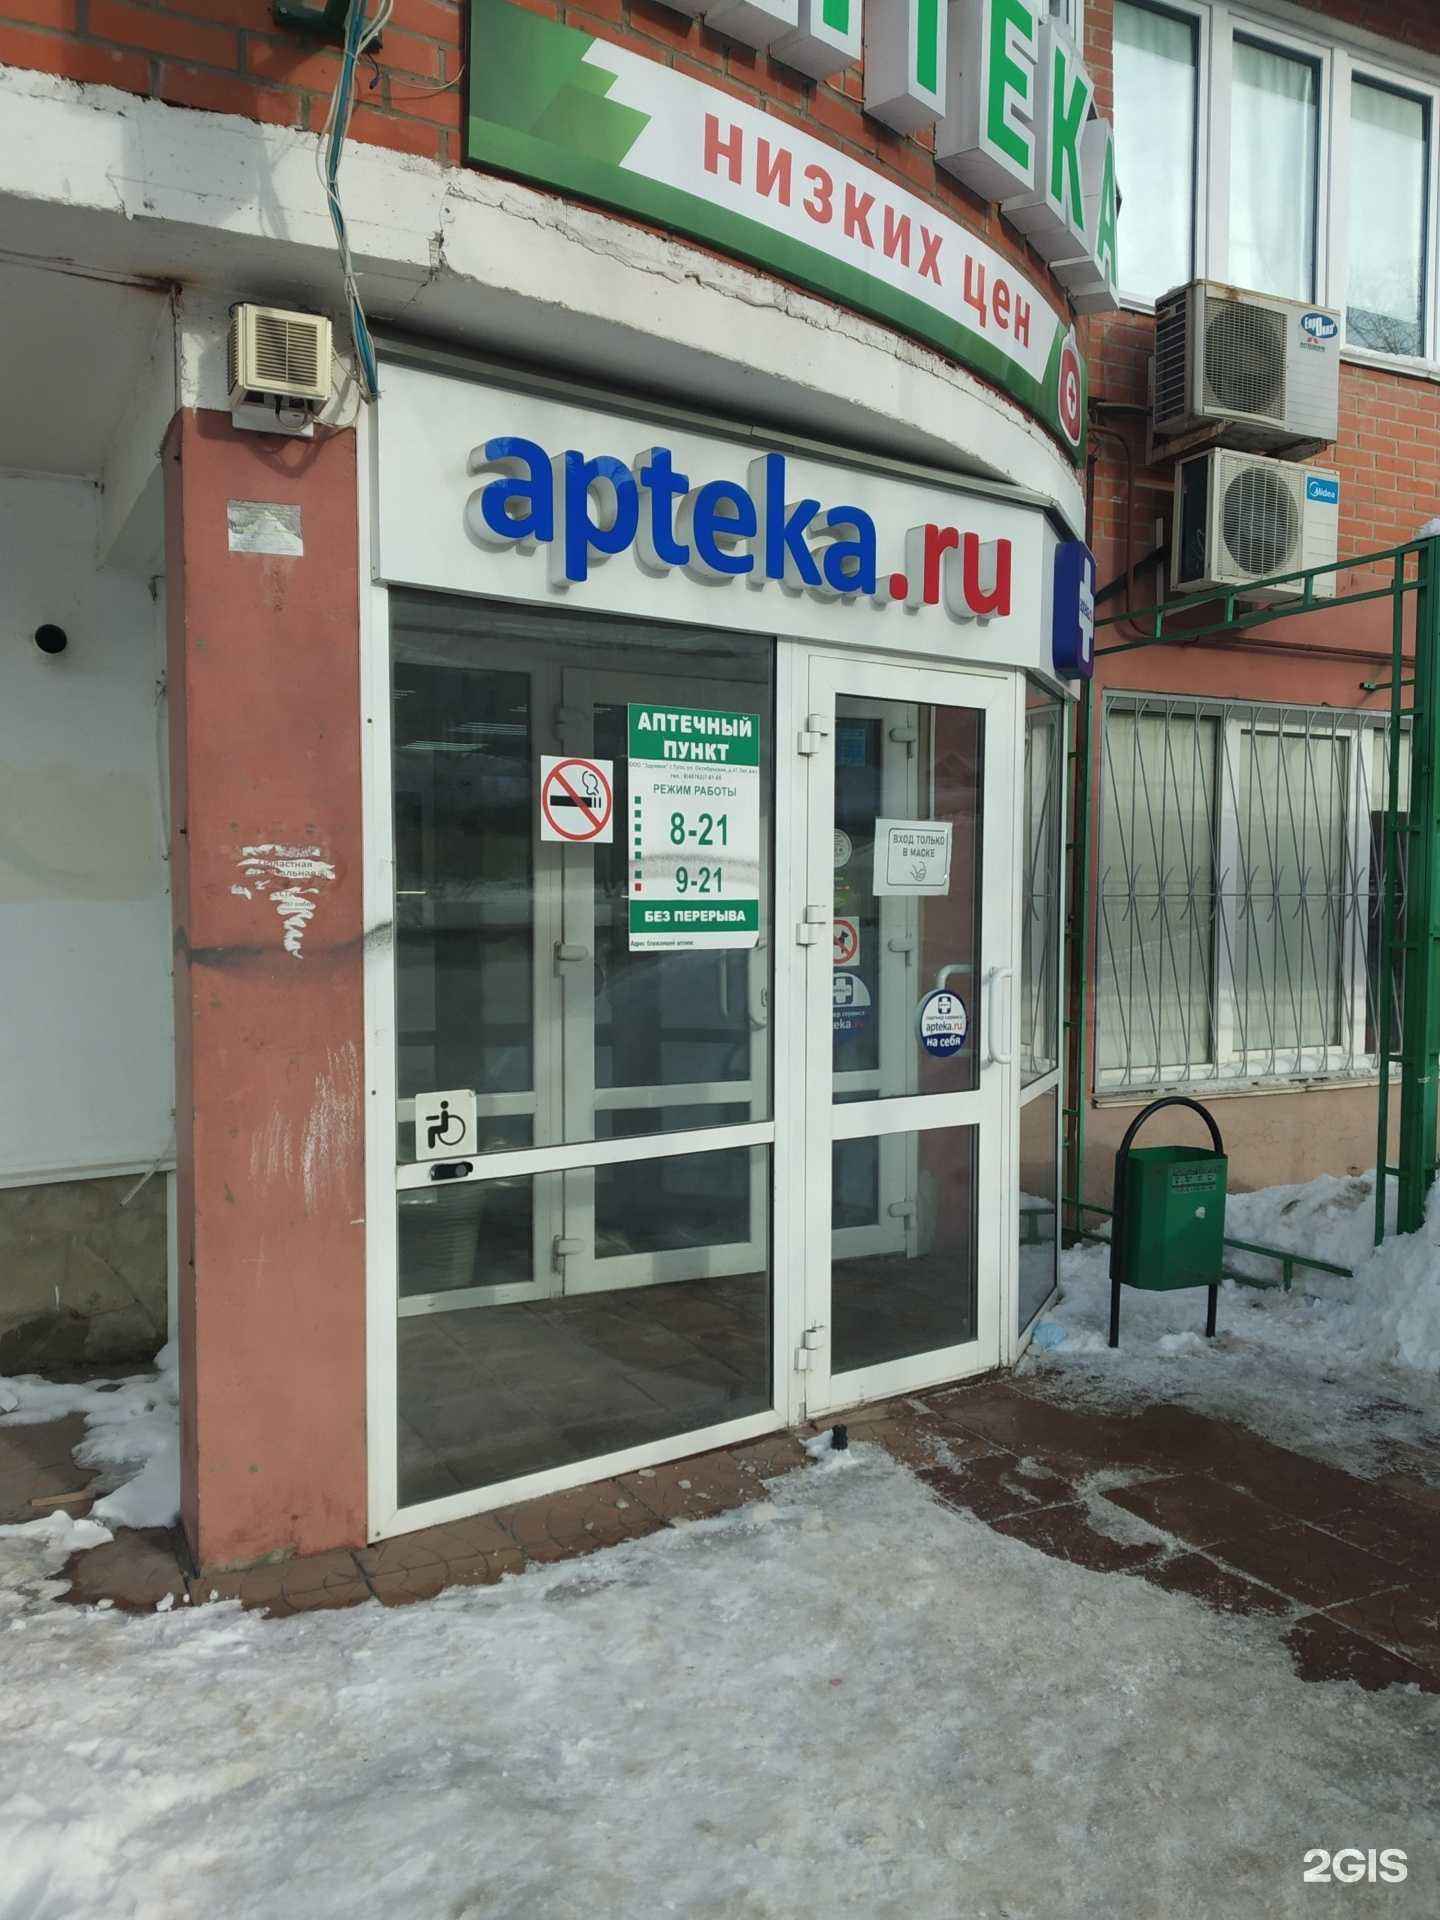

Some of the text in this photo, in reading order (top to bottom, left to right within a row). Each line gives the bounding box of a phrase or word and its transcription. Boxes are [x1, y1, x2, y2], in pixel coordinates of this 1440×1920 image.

[638, 712, 752, 738] АПТЕЧНЫЙ
[663, 740, 730, 761] ПУНКТ
[653, 783, 737, 797] РЕЖИМ РАБОТЫ
[670, 812, 728, 846] 8-21
[893, 834, 945, 846] ВХОД ТОЛЬКО
[903, 847, 935, 858] В МАСКЕ
[675, 866, 723, 893] 9-21
[644, 910, 746, 923] БЕЗ ПЕРЕРЫВА
[926, 1021, 963, 1033] apteka.ru
[926, 1035, 961, 1047] на себя
